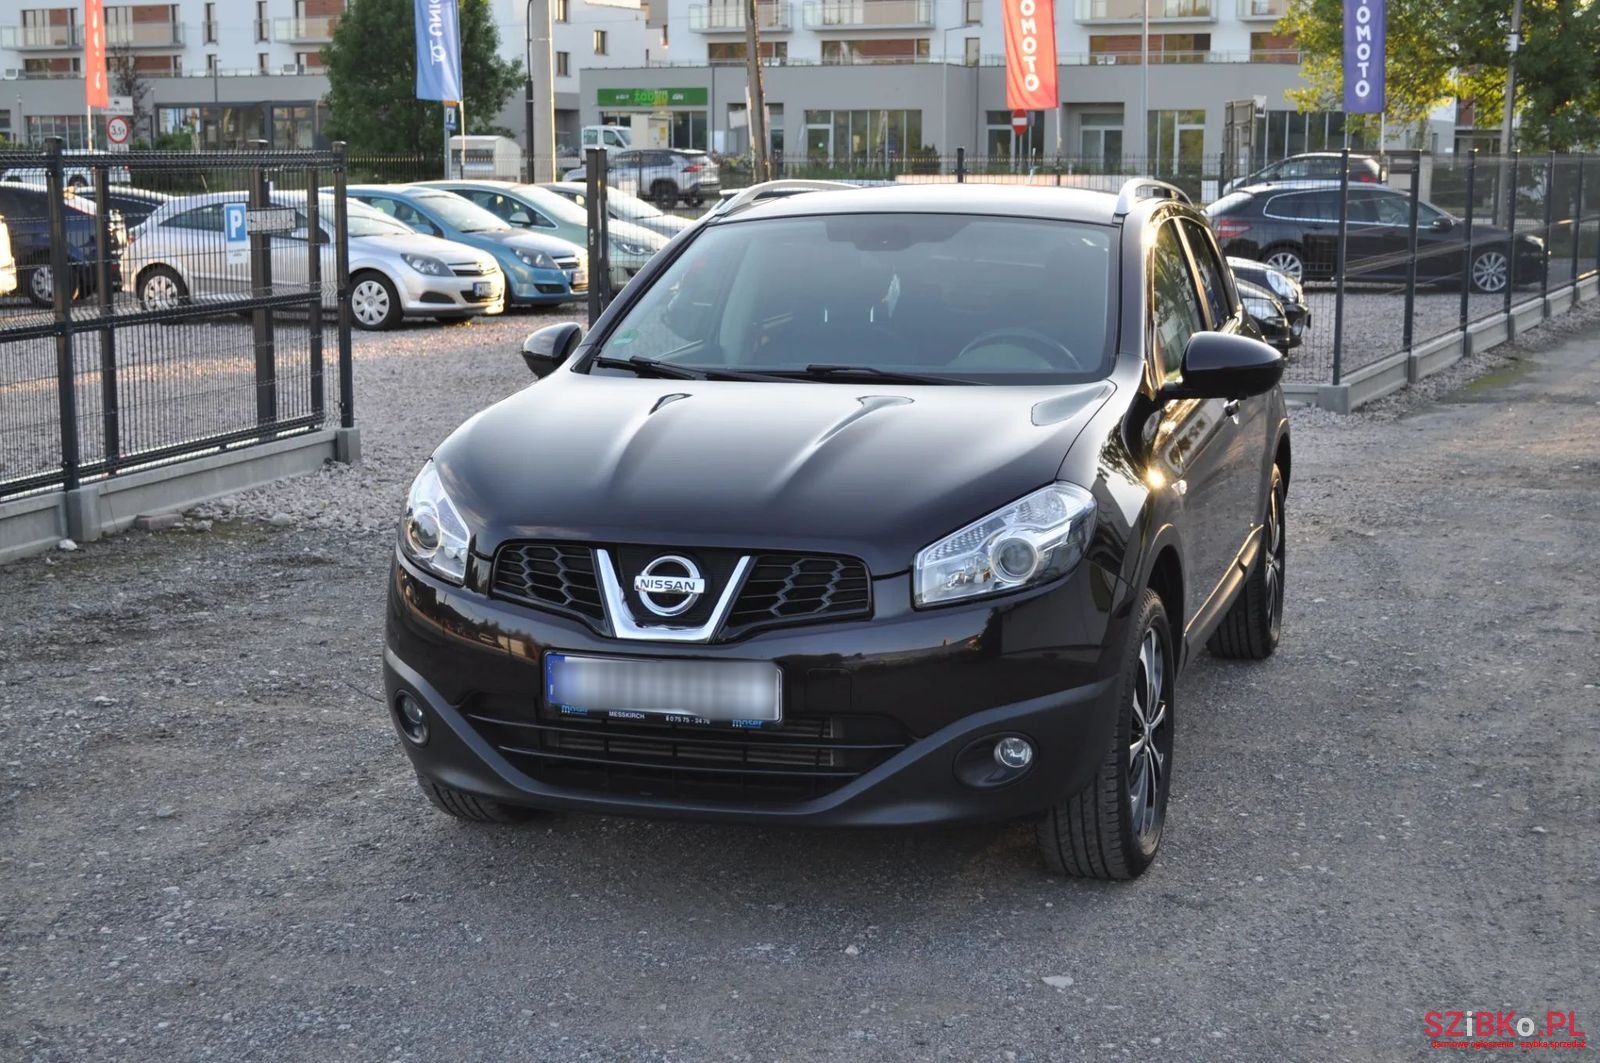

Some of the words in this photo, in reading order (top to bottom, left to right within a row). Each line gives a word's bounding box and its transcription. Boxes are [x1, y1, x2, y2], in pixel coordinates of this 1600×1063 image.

[1355, 0, 1371, 98] OMOTO
[230, 209, 242, 238] P
[640, 579, 695, 591] NISSAN
